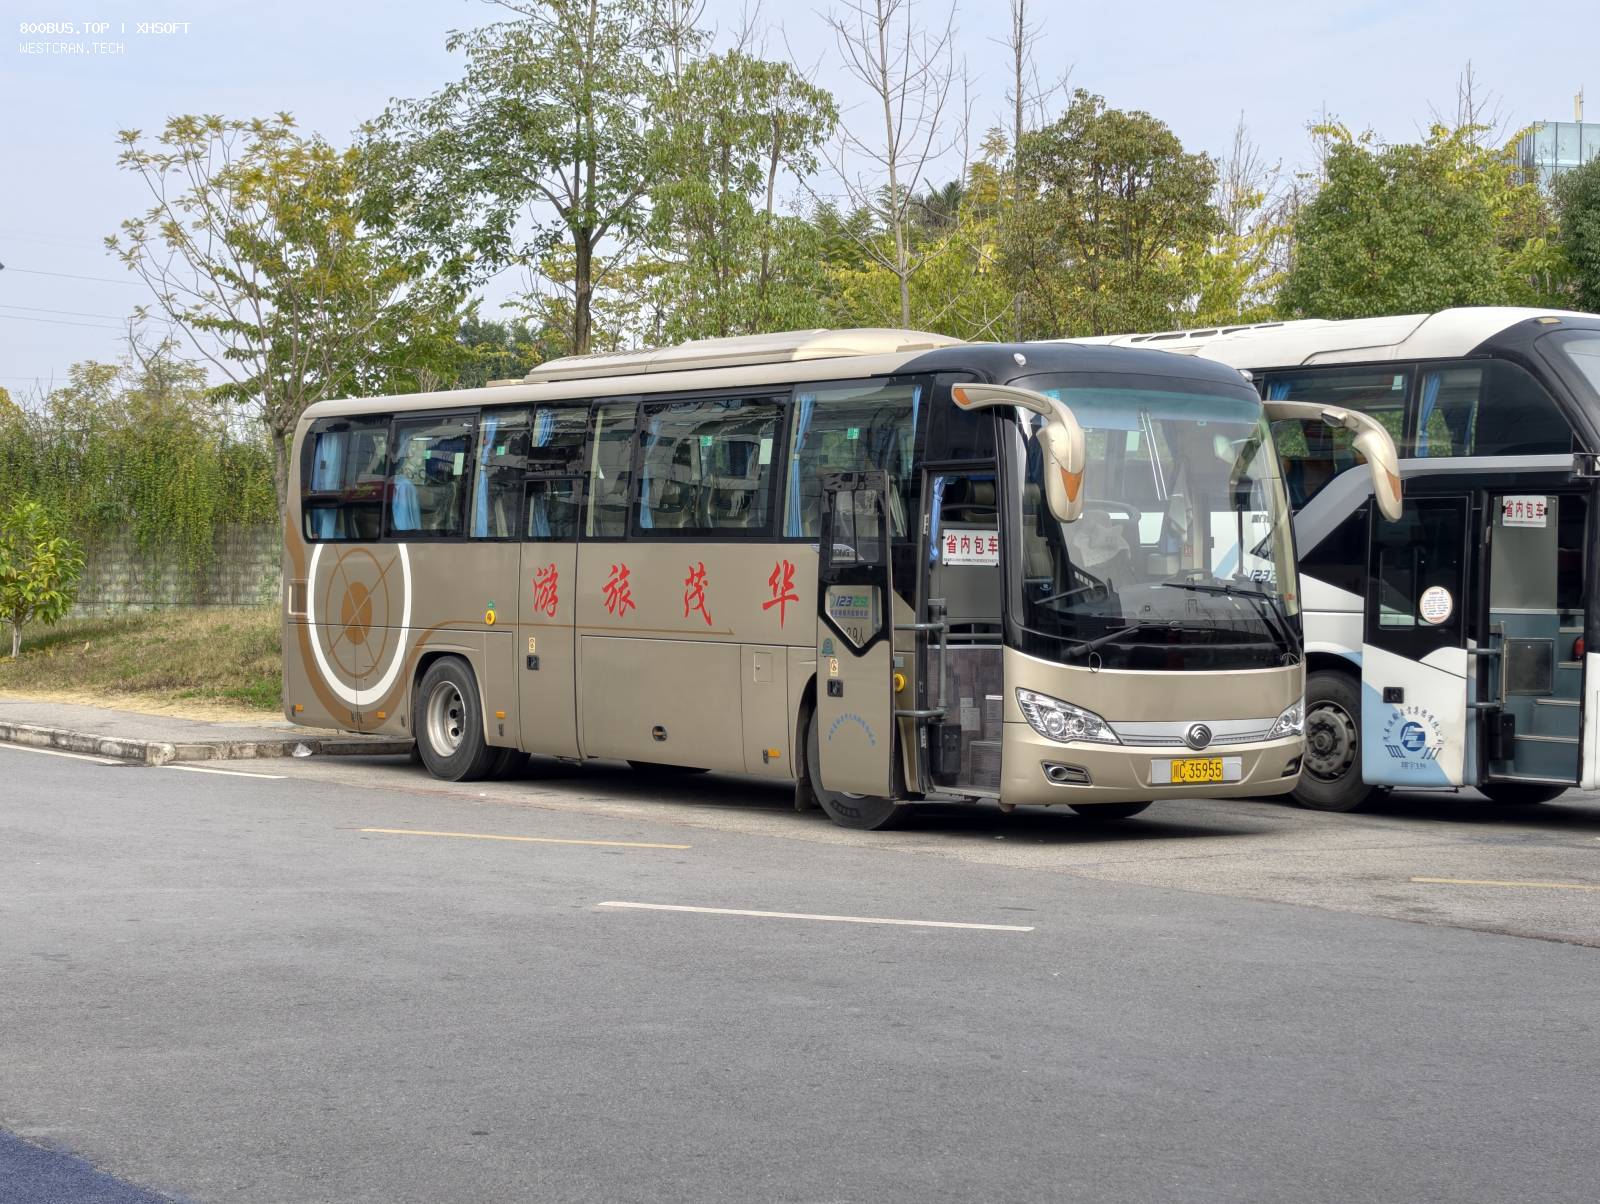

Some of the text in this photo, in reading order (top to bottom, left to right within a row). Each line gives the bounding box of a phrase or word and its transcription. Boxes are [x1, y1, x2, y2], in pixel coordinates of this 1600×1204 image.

[1505, 499, 1544, 519] 省内包车
[946, 533, 998, 555] 省内包车
